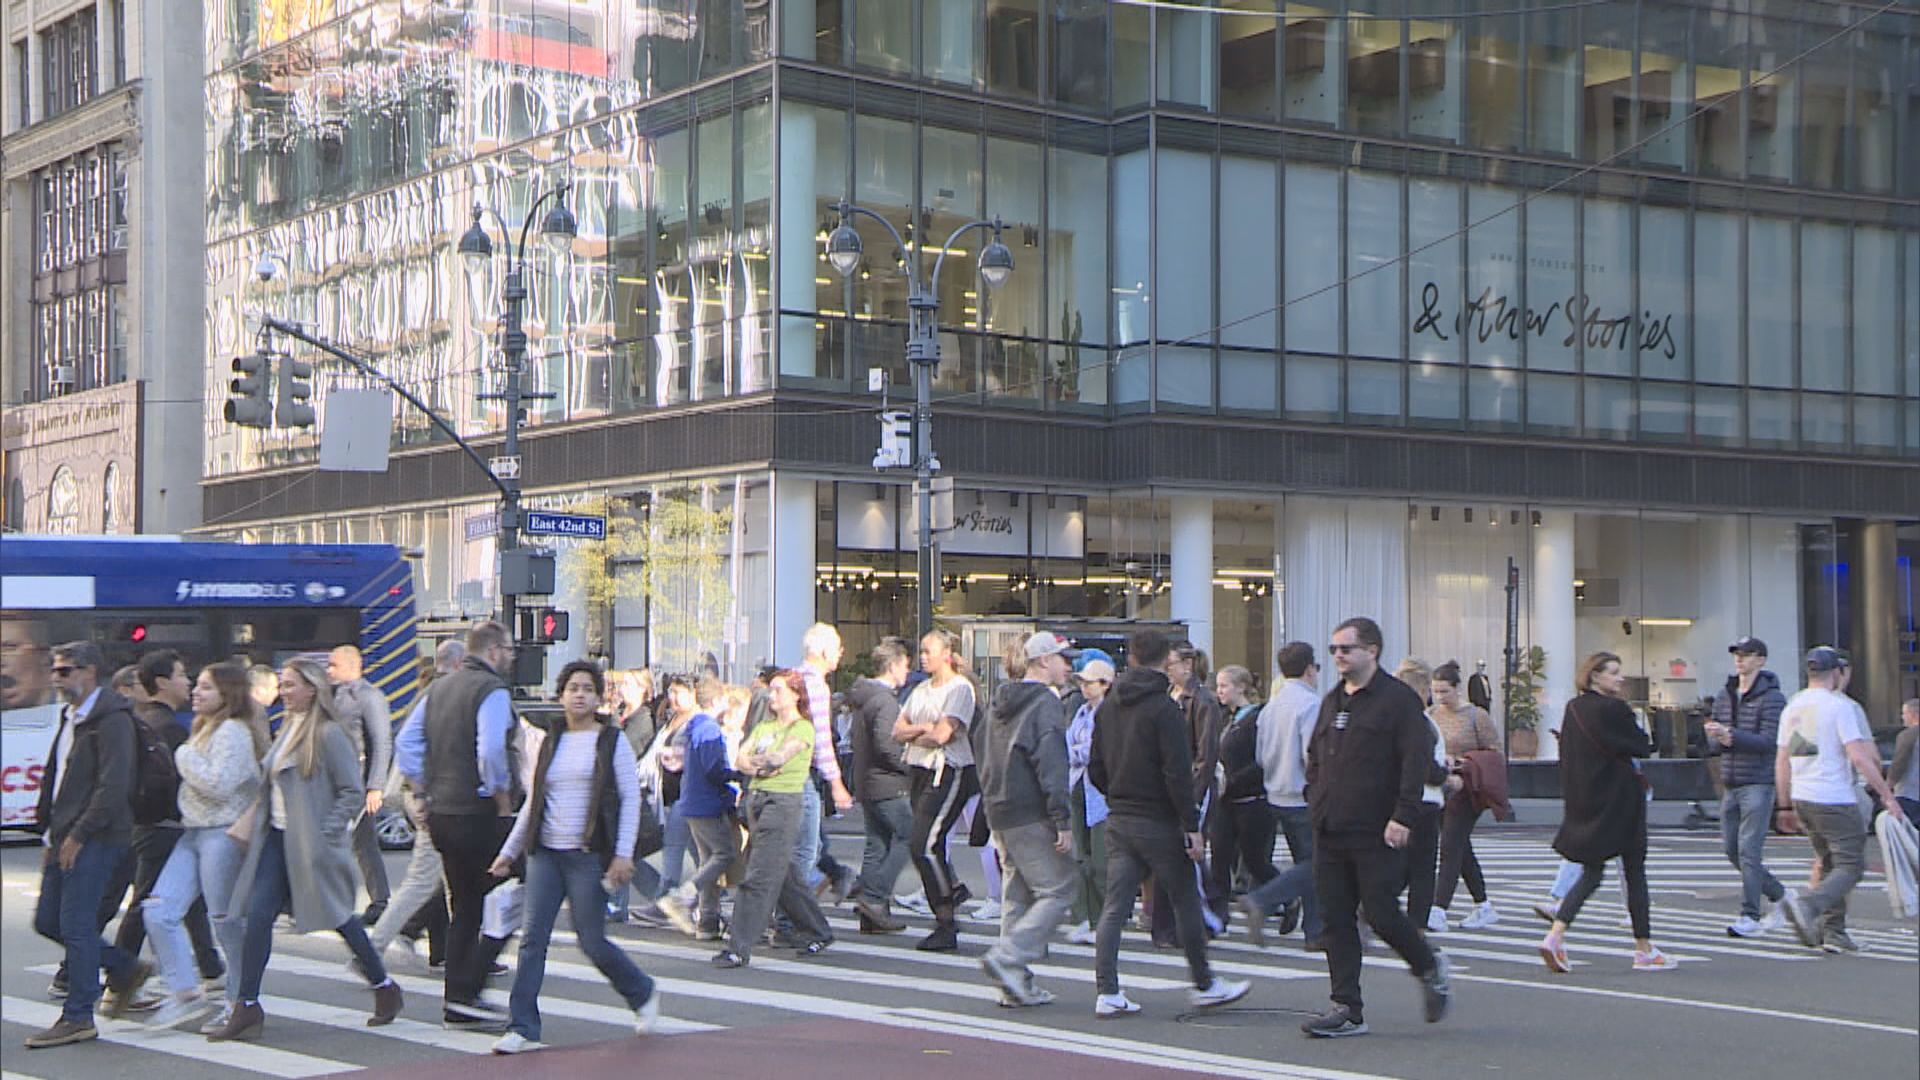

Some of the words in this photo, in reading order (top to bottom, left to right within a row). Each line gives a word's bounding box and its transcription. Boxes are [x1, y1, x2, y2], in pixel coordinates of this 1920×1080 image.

[1413, 282, 1448, 341] &
[1564, 293, 1676, 360] Stories
[530, 516, 556, 530] East
[558, 519, 586, 533] 42nd
[588, 521, 601, 534] St
[970, 510, 1013, 535] Stories
